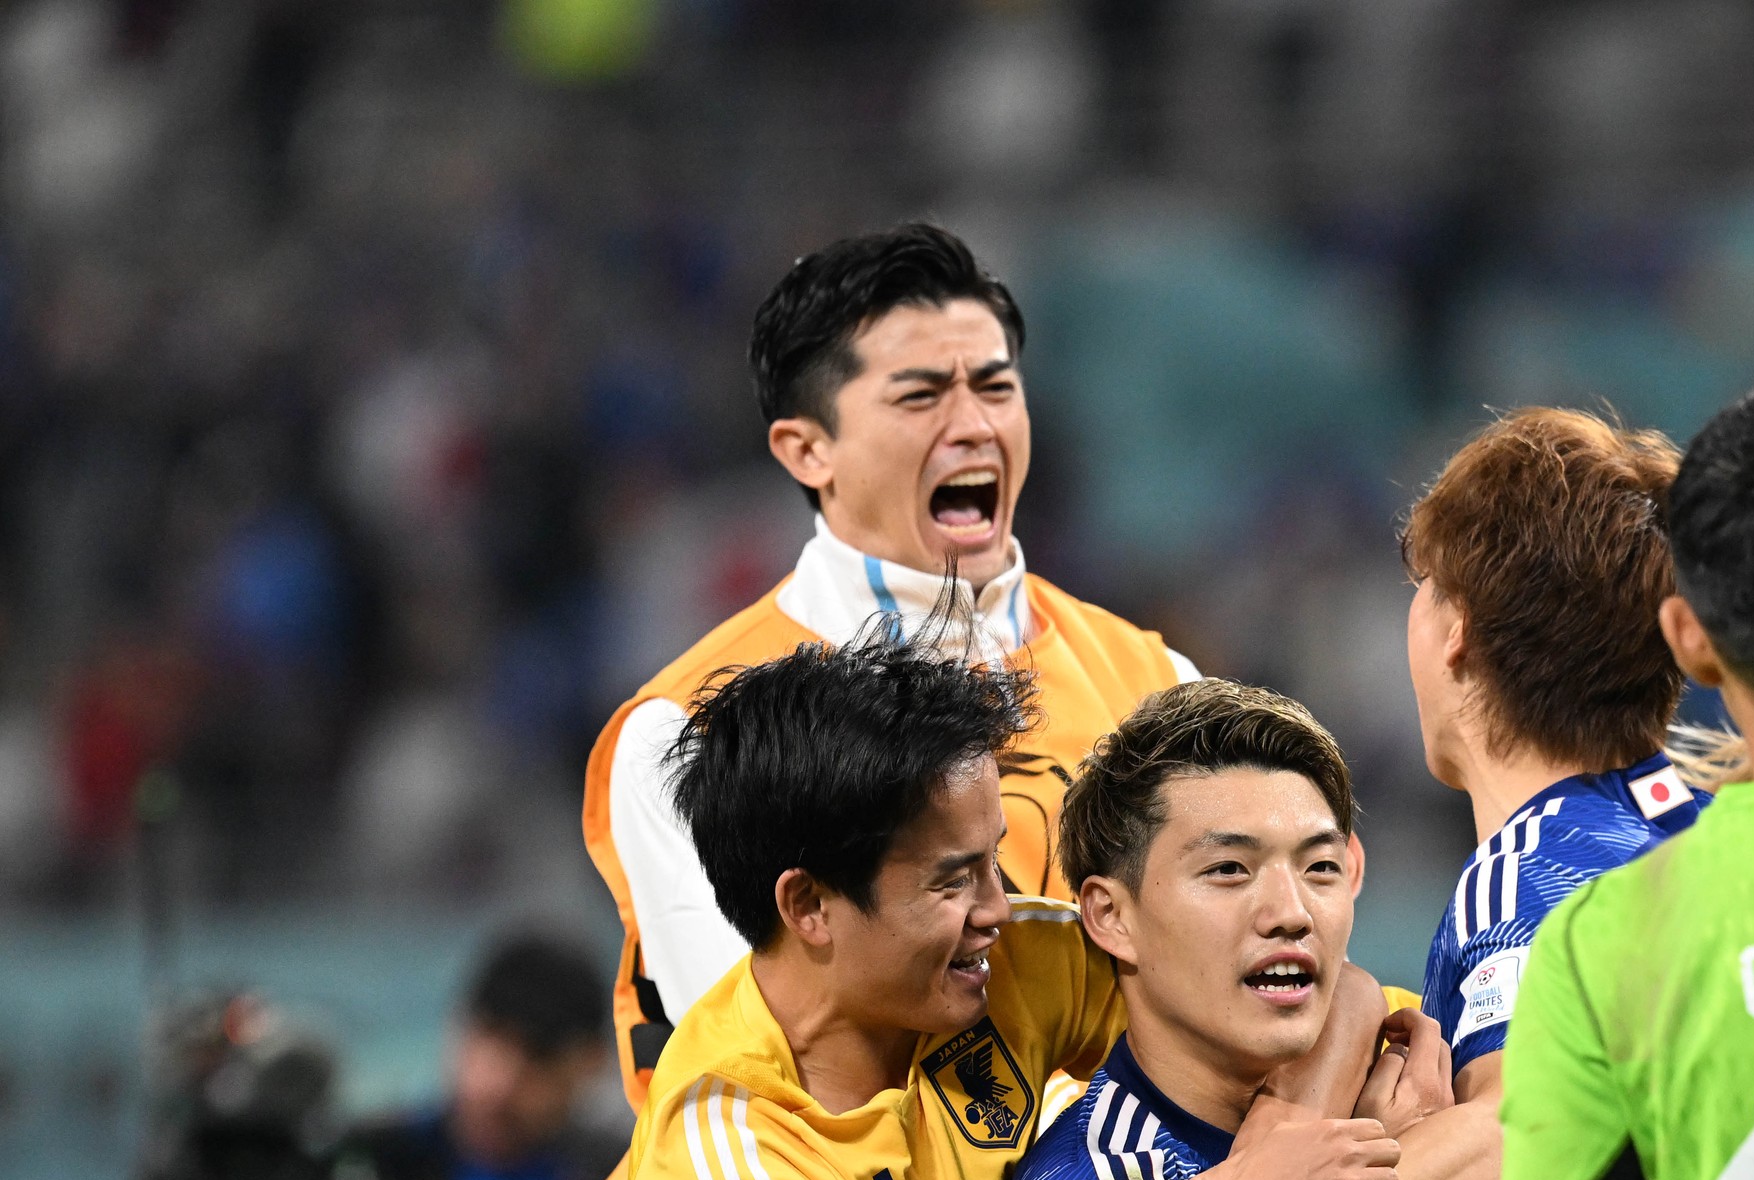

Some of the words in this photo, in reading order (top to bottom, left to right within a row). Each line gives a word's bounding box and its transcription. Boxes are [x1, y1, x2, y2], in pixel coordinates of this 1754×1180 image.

[1469, 994, 1503, 1010] UNITES
[938, 1030, 976, 1062] JAPAN
[983, 1105, 1019, 1139] JFA
